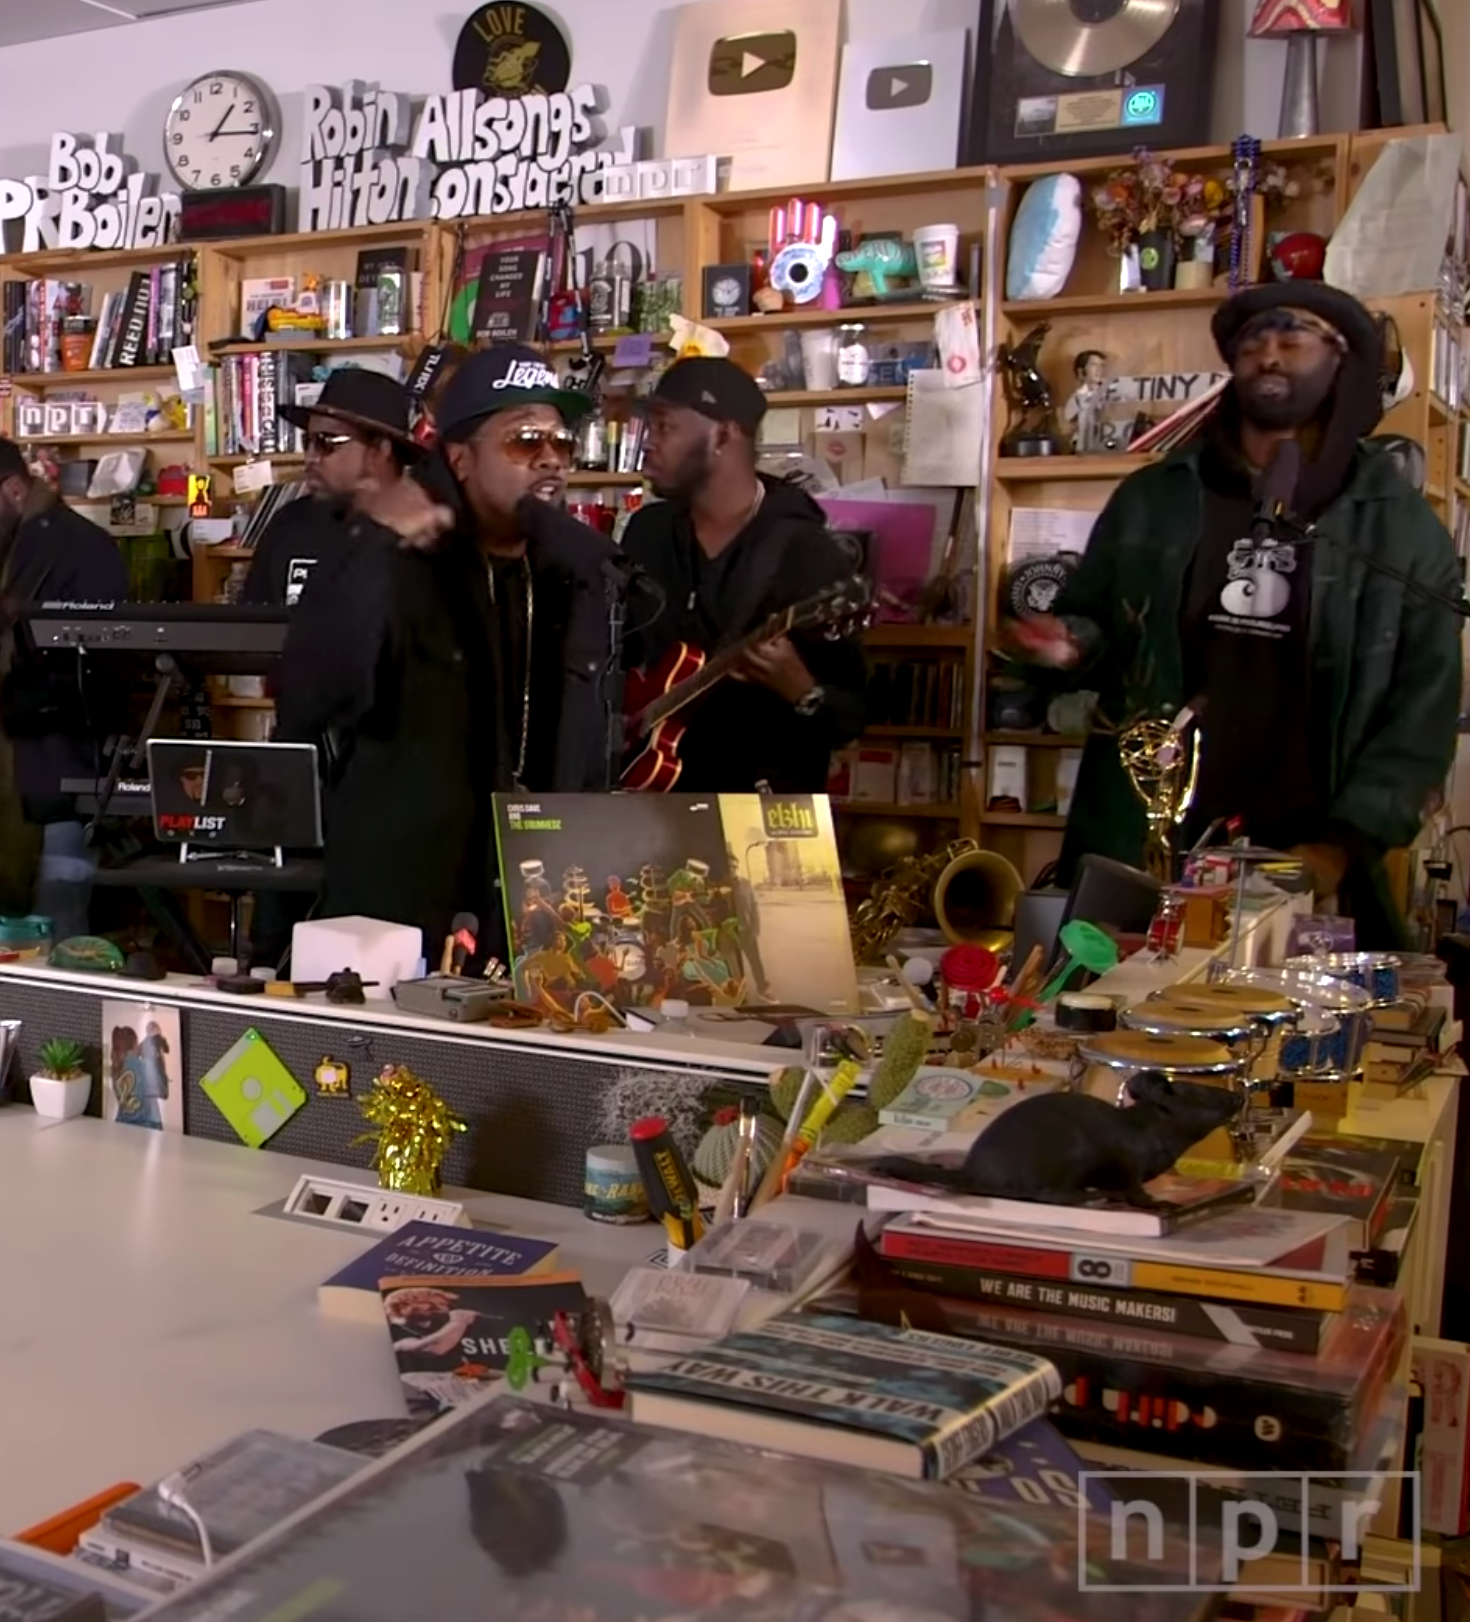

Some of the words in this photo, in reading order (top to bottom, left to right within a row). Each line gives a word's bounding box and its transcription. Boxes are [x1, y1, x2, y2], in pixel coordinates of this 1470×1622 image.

[473, 7, 527, 42] LOVE
[194, 91, 202, 103] 11
[210, 83, 223, 95] 12
[233, 87, 238, 98] 1
[243, 101, 254, 113] 2
[180, 109, 190, 122] 10
[249, 123, 260, 134] 3
[302, 78, 410, 164] Robin
[410, 85, 604, 172] Allsongs
[172, 133, 183, 145] 9
[178, 155, 189, 166] 8
[244, 147, 254, 158] 4
[49, 132, 123, 194] Bob
[192, 170, 201, 182] 7
[210, 173, 221, 186] 6
[230, 165, 241, 178] 5
[607, 163, 703, 198] npr
[298, 148, 424, 232] Hilton
[1133, 374, 1201, 401] TINY
[26, 406, 93, 433] npr
[62, 599, 115, 610] Roland
[117, 781, 152, 792] Roland
[160, 812, 226, 831] PLAYLIST
[397, 1235, 523, 1267] APPETITE
[385, 1252, 494, 1277] DEFINITION
[979, 1276, 1003, 1296] WE
[1006, 1280, 1033, 1300] ARE
[1037, 1284, 1063, 1305] THE
[1067, 1288, 1110, 1314] MUSIC
[1114, 1294, 1177, 1324] MAKERS!
[664, 1358, 732, 1382] WAY
[743, 1374, 833, 1401] THIS
[834, 1390, 944, 1423] WALK
